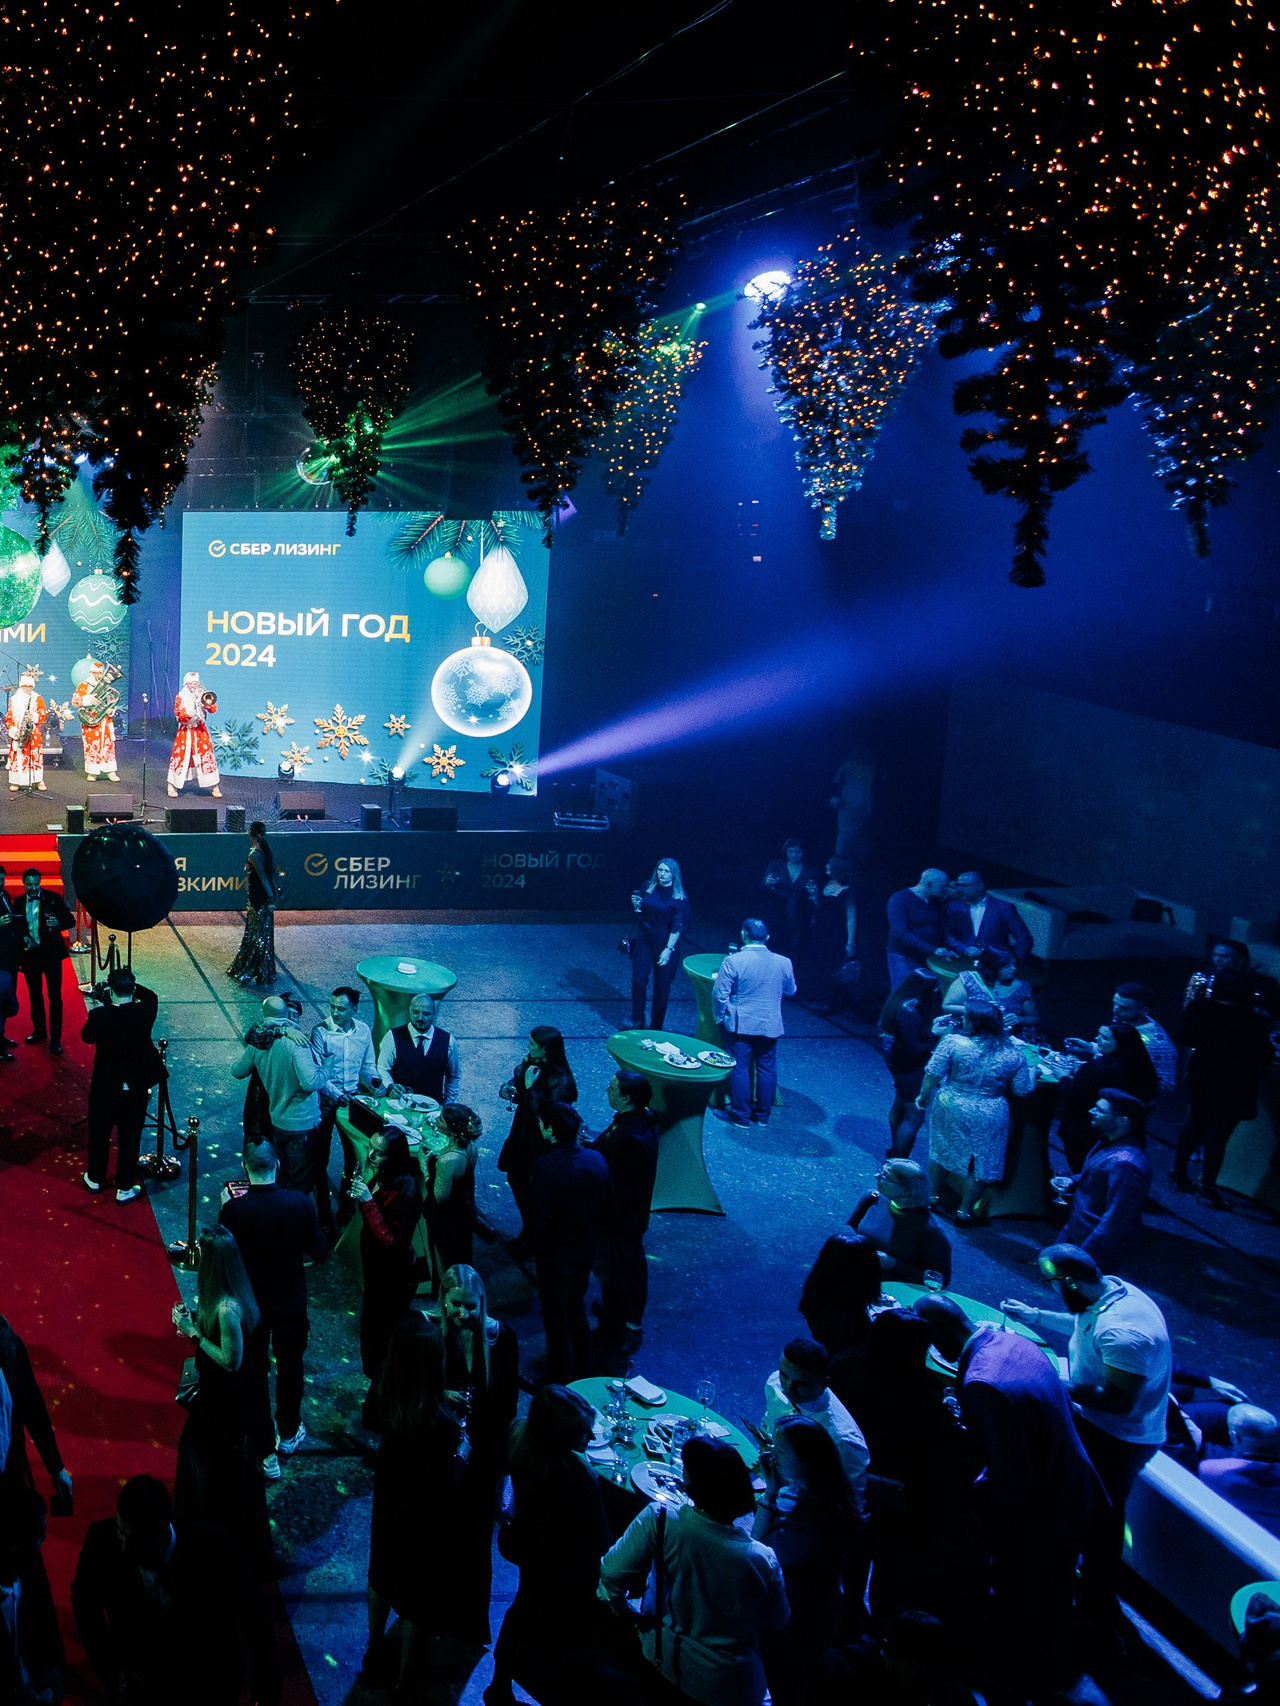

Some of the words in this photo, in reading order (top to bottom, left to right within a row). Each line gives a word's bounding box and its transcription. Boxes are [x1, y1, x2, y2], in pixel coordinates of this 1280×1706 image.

[229, 543, 272, 555] СБЕР
[273, 543, 342, 556] ЛИЗИНГ
[207, 607, 330, 637] НОВЫЙ
[341, 613, 411, 643] ГОД
[205, 642, 277, 668] 2024
[334, 856, 391, 872] СБЕР
[482, 850, 559, 868] НОВЫЙ
[566, 853, 607, 870] ГОД
[333, 874, 422, 889] ЛИЗИНГ
[480, 873, 526, 889] 2024
